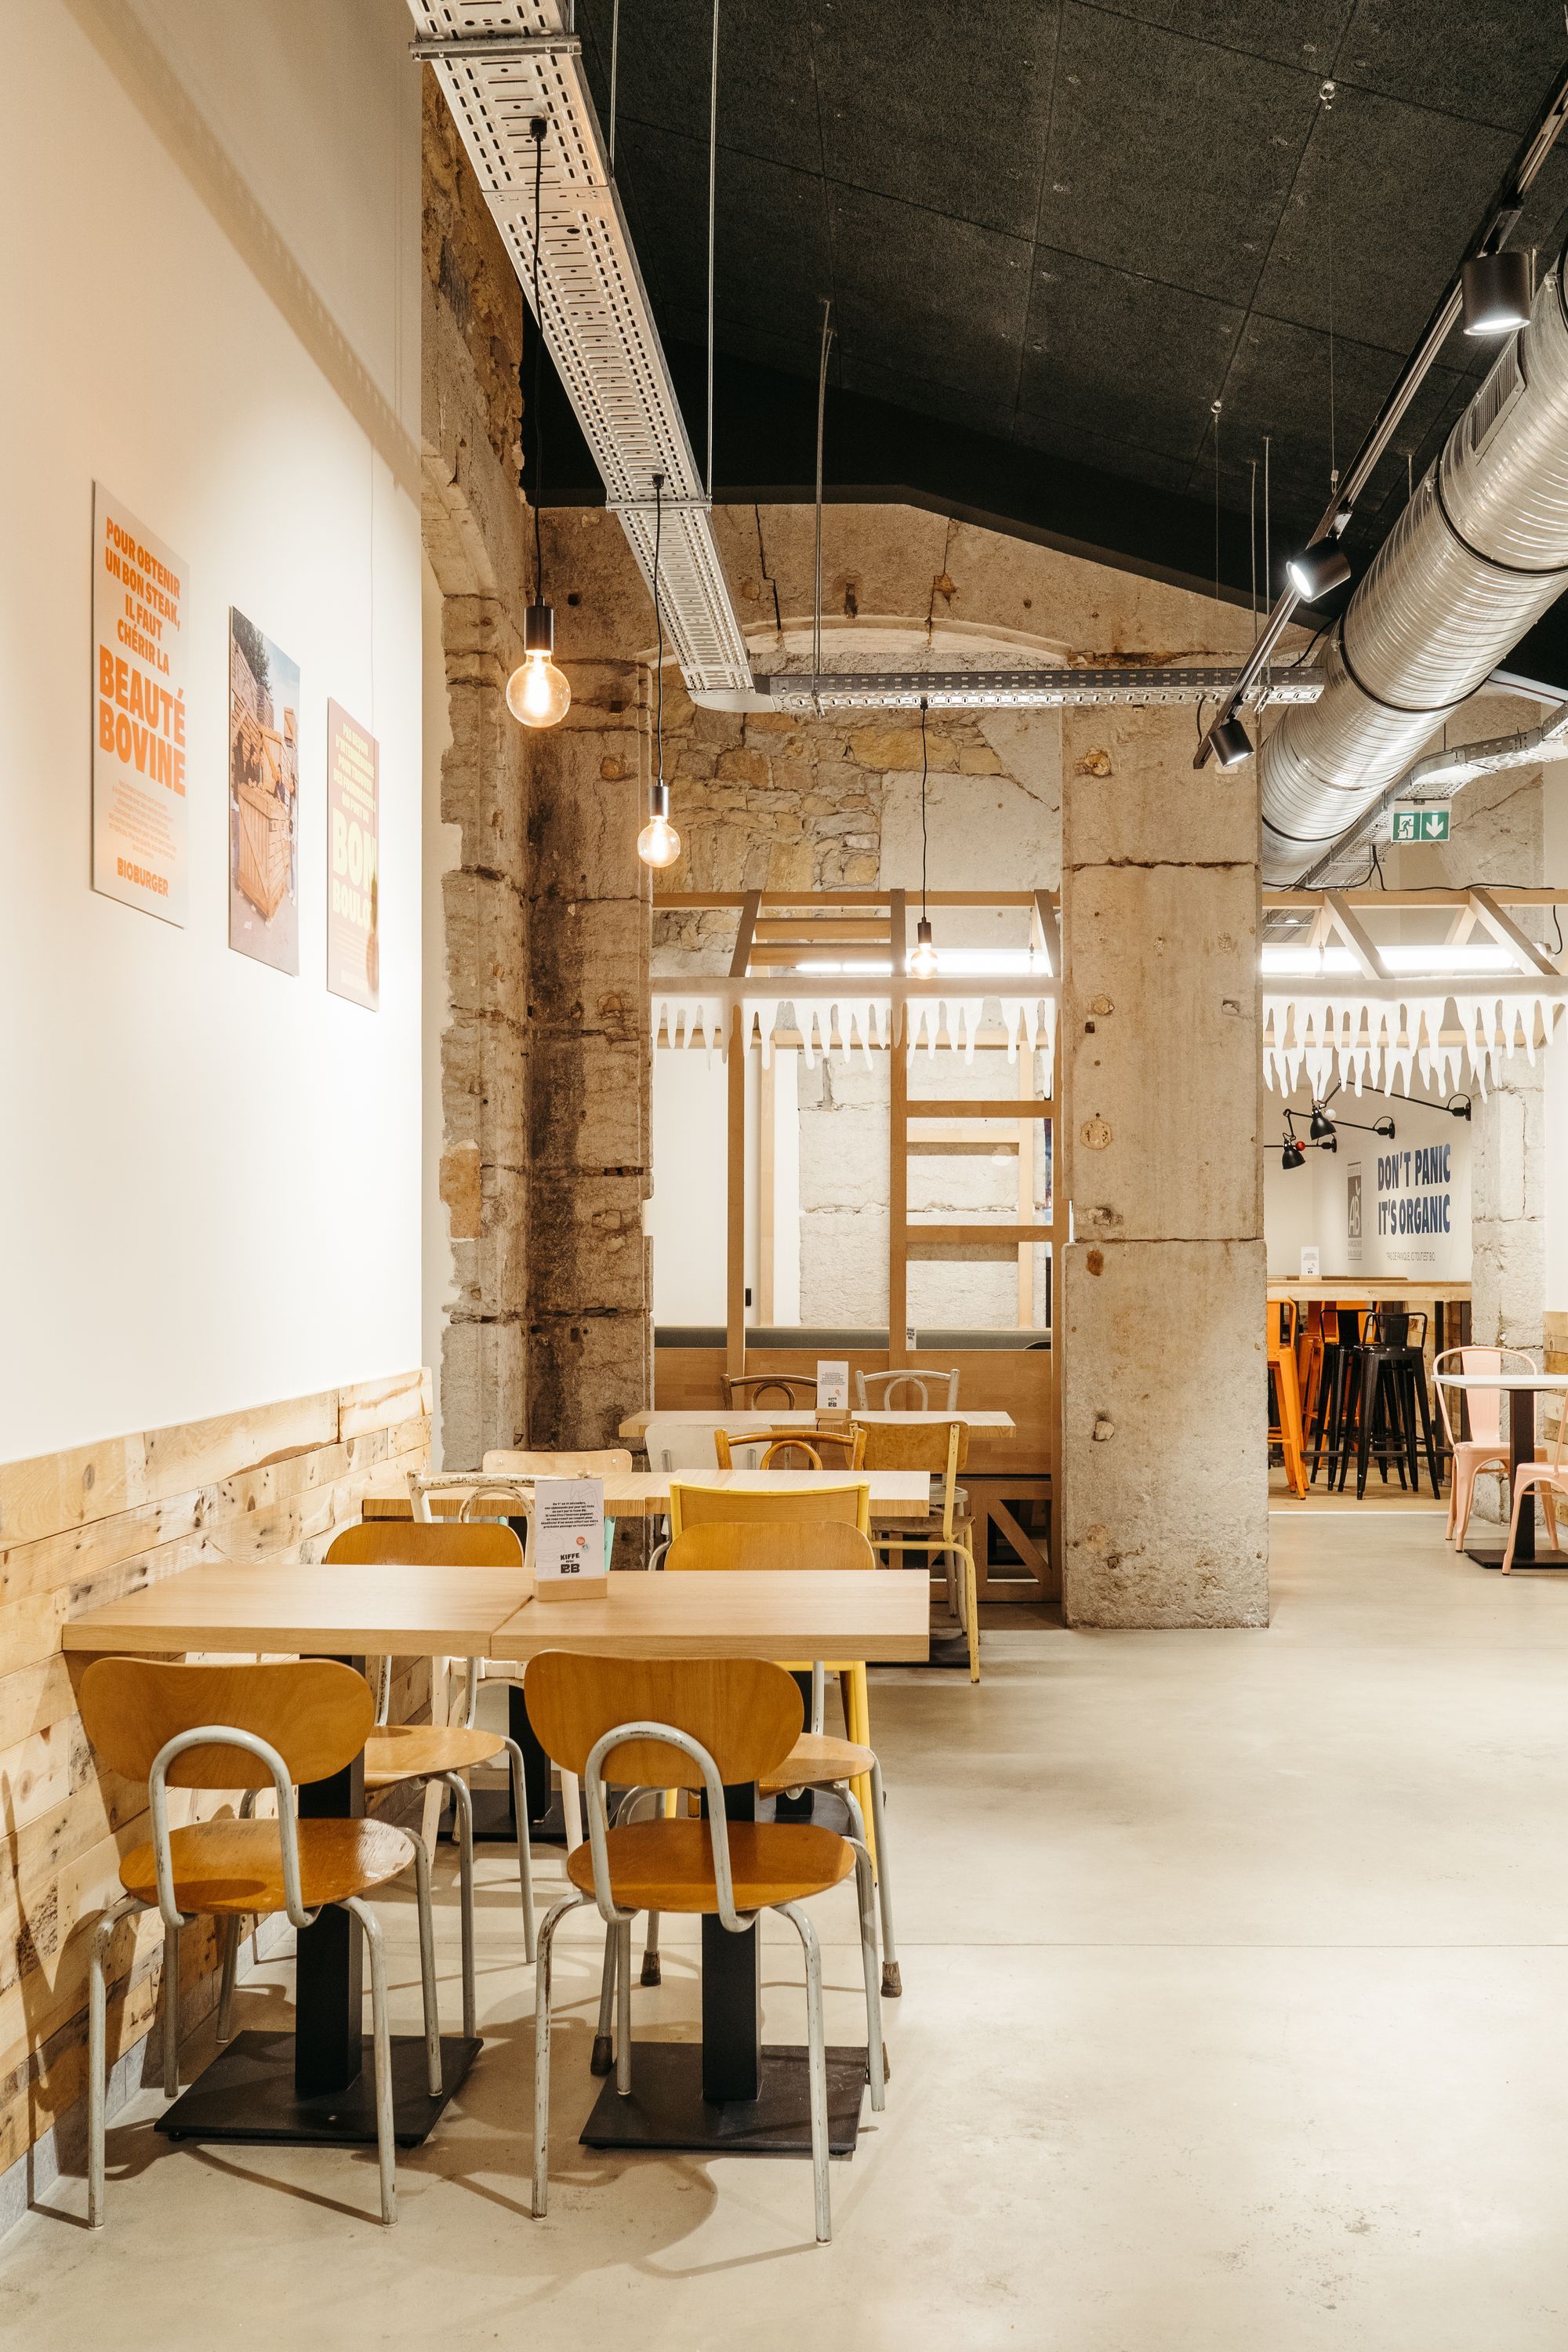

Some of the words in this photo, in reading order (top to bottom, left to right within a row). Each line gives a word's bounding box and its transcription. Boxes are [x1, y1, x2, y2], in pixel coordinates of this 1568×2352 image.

[106, 515, 135, 563] POUR
[136, 542, 180, 601] OBTENIR
[105, 546, 120, 580] UN
[122, 560, 143, 599] BON
[145, 579, 180, 632] STEAK,
[125, 593, 136, 622] IL
[136, 602, 162, 643] FAUT
[118, 615, 155, 666] CHÉRIR
[157, 646, 169, 676] LA
[100, 644, 186, 749] BEAUTÉ
[99, 699, 185, 797] BOVINE
[117, 856, 169, 898] BIOBURGER
[332, 805, 376, 898] BON
[332, 877, 376, 935] BOULO
[1377, 1151, 1411, 1192] DON'T
[1414, 1143, 1451, 1186] PANIC
[1378, 1199, 1397, 1236] IT'S
[1399, 1193, 1450, 1235] ORGANIC
[560, 1552, 580, 1561] KIFFE
[560, 1563, 580, 1574] BB
